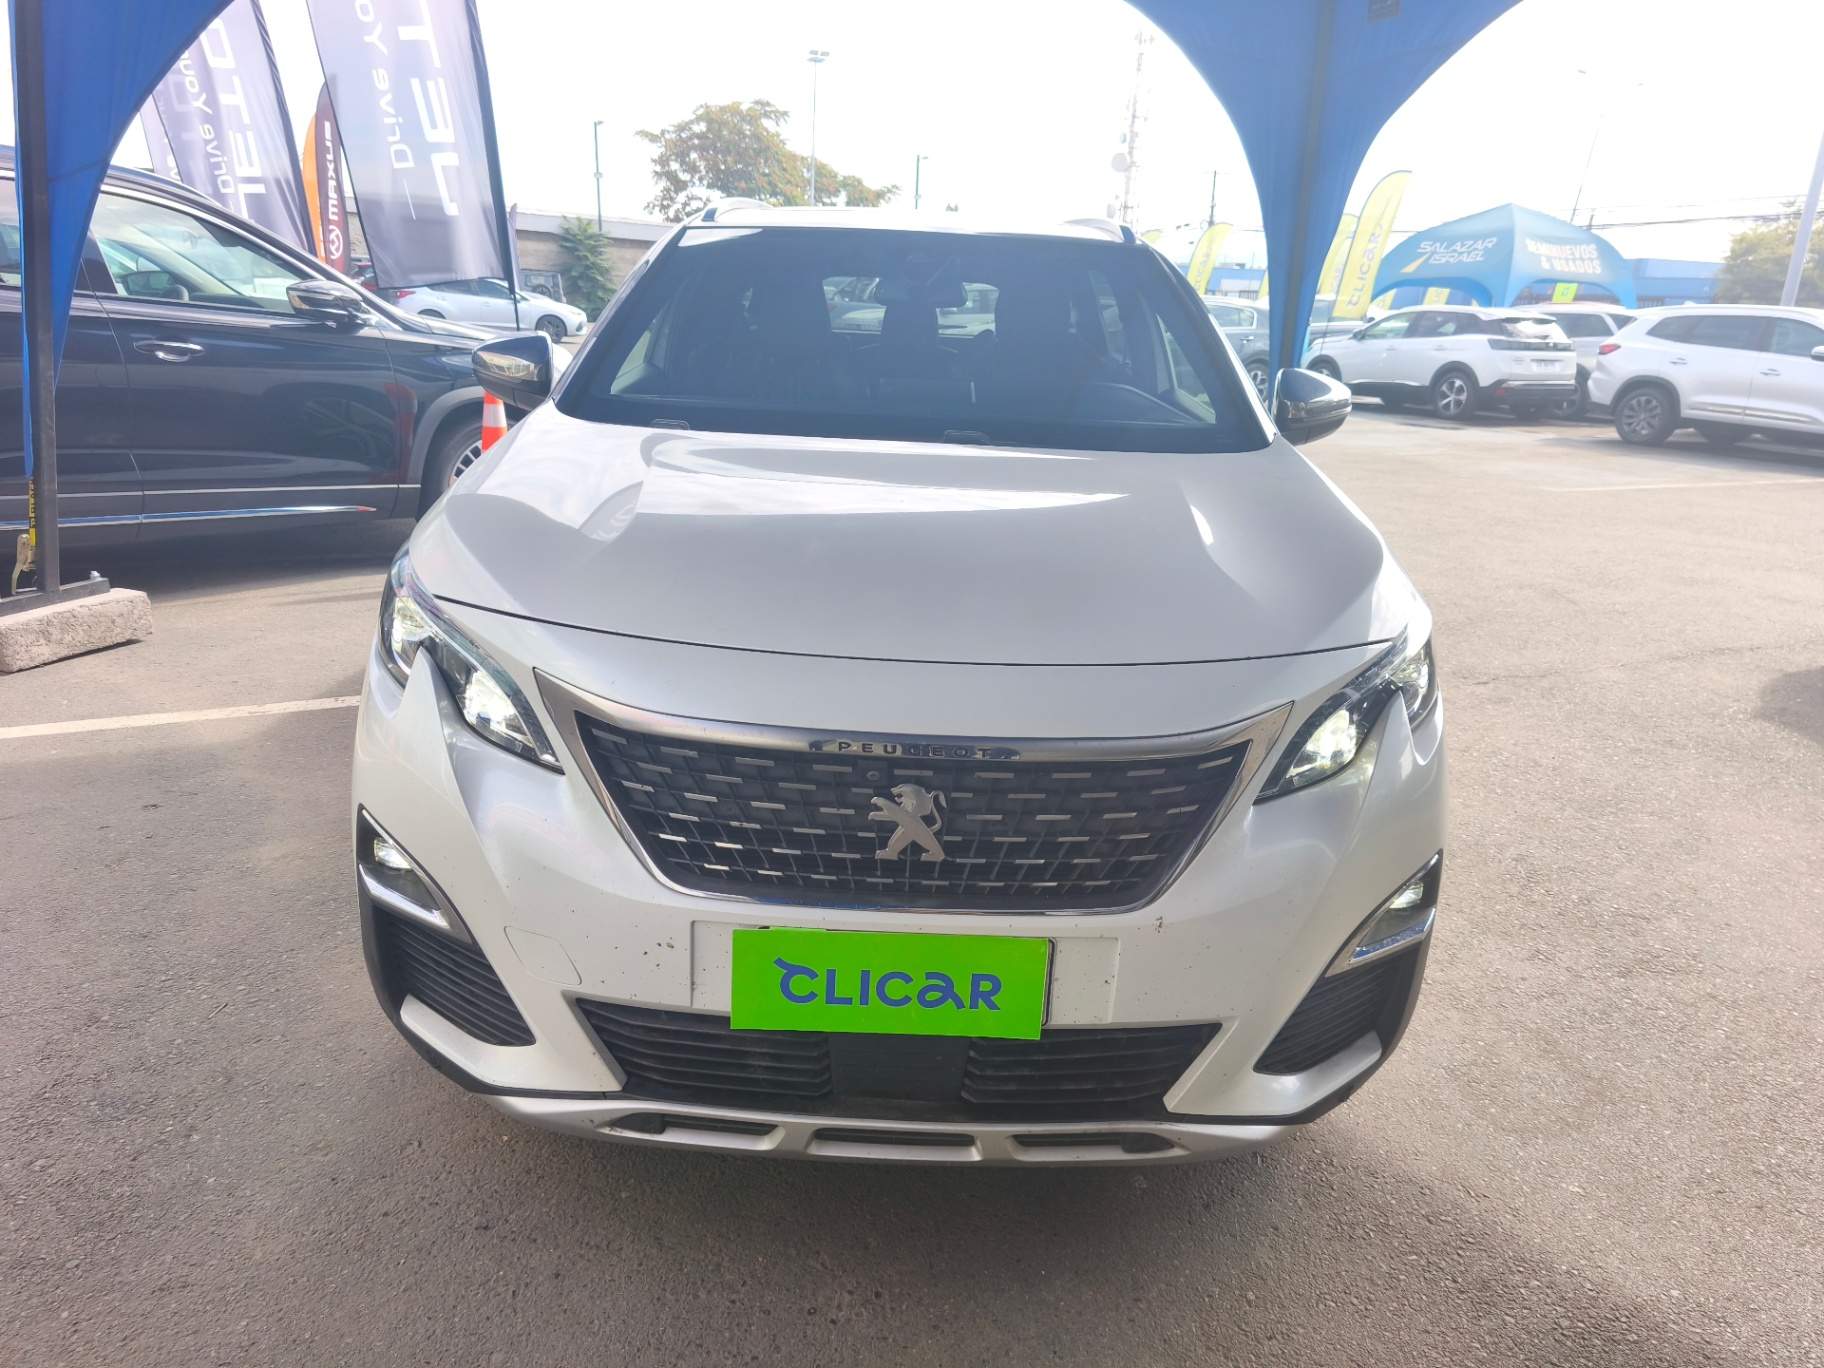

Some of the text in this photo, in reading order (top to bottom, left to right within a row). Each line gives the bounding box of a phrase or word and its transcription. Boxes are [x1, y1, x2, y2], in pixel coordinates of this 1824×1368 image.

[324, 121, 339, 221] MAXUS
[1417, 236, 1498, 253] SALAZAR
[1428, 249, 1486, 265] ISRAEL
[838, 741, 992, 760] PEUGEOT
